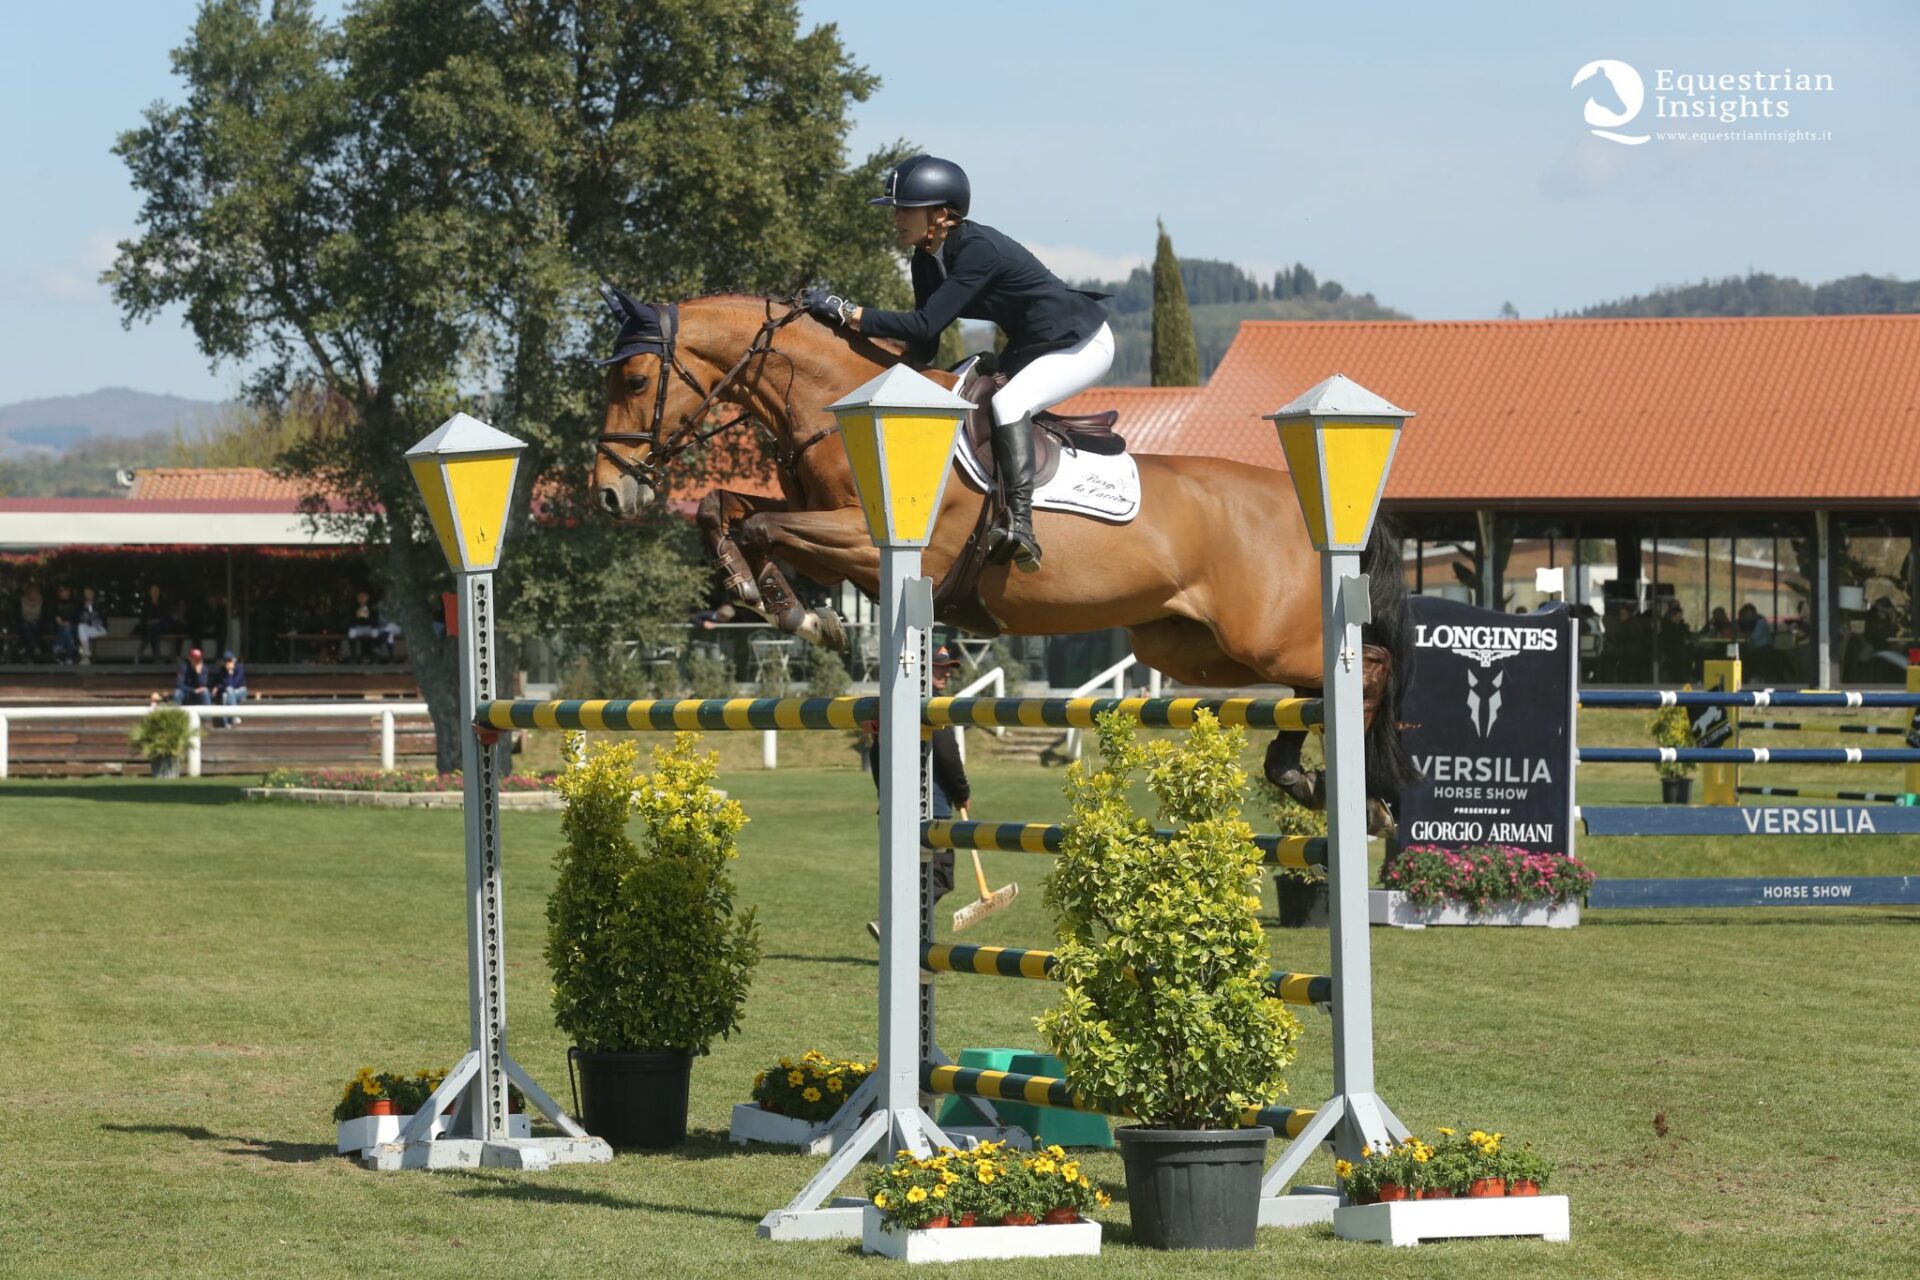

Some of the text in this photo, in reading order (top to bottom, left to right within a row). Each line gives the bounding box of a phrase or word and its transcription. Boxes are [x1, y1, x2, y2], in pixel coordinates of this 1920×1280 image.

[1415, 625, 1558, 651] LONGINES
[1411, 755, 1552, 783] VERSILIA
[1434, 786, 1528, 800] HORSE SHOW
[1454, 807, 1498, 815] PRESENTED
[1742, 808, 1876, 833] VERSILIA
[1411, 821, 1553, 843] GIORGIO ARMANI
[1763, 885, 1852, 898] HORSE SHOW
